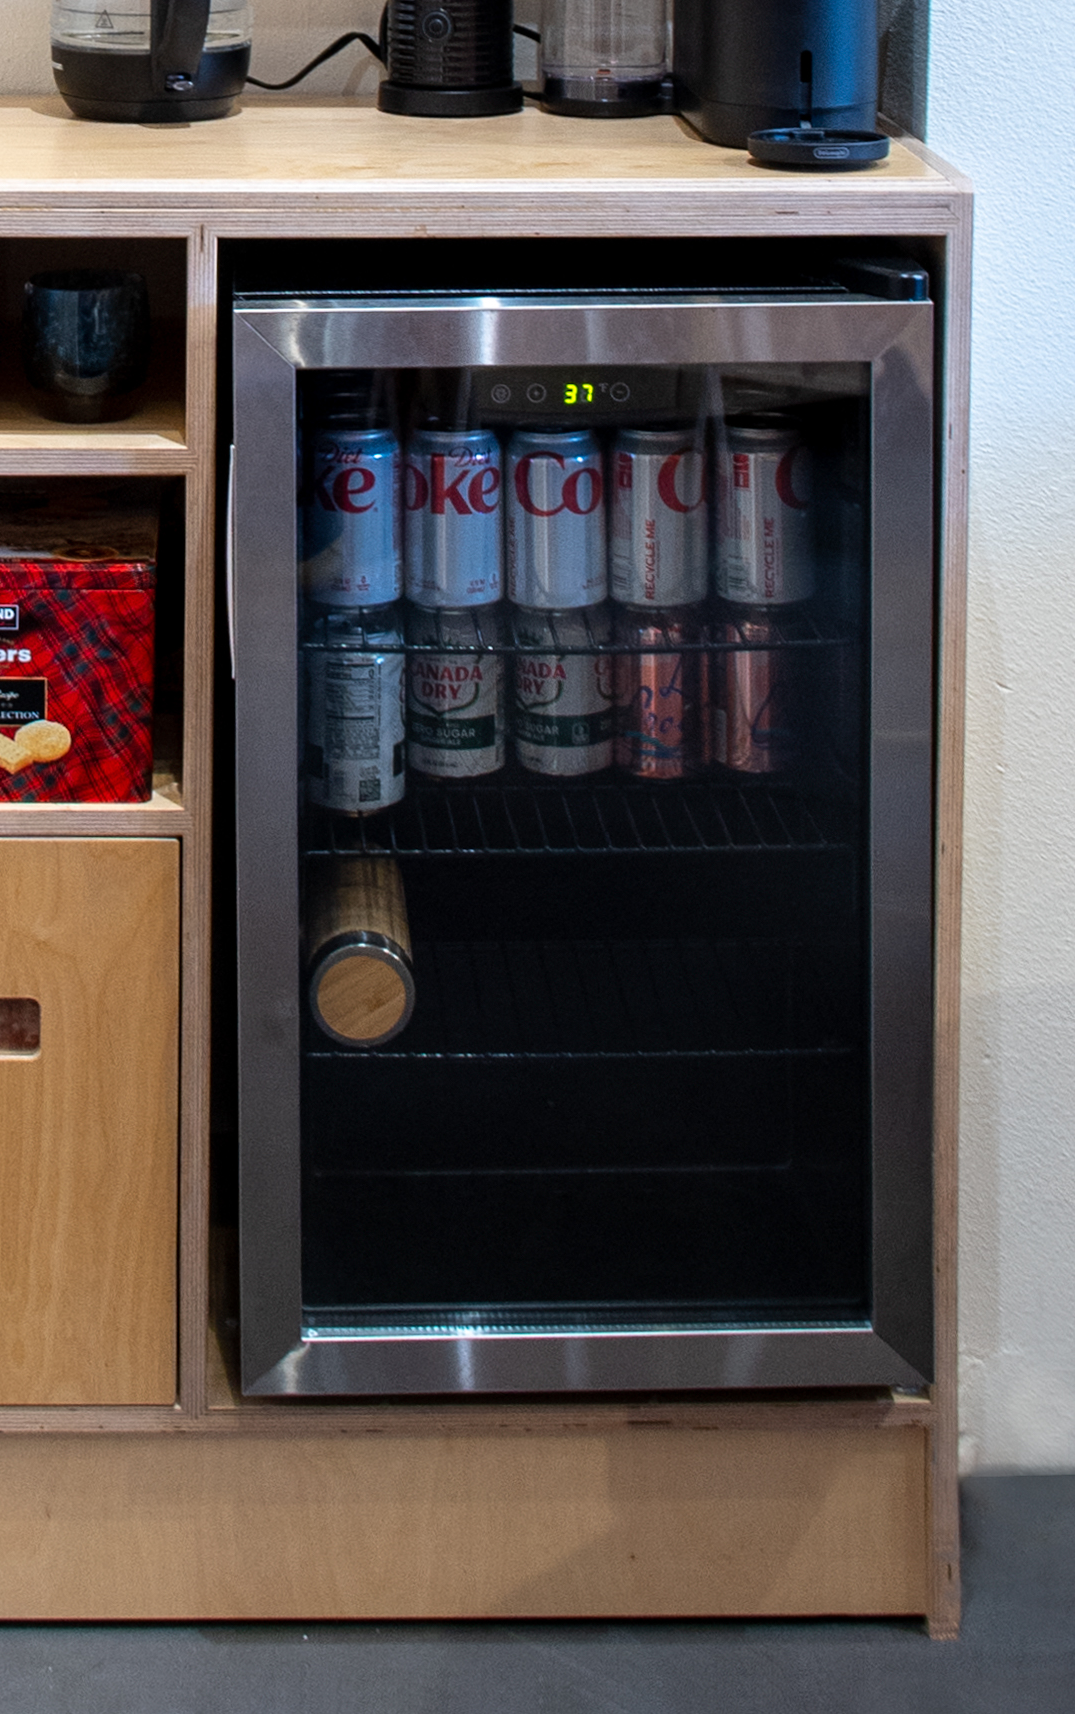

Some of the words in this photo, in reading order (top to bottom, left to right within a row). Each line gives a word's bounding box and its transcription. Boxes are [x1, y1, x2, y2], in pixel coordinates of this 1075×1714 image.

[564, 383, 594, 405] 37
[317, 441, 363, 465] Diet
[449, 446, 494, 468] Diet
[645, 519, 656, 539] ME
[763, 517, 775, 536] ME
[645, 543, 656, 600] RECYCLE
[763, 541, 775, 599] RECYCLE
[421, 681, 462, 700] DRY
[436, 727, 476, 739] SUGAR
